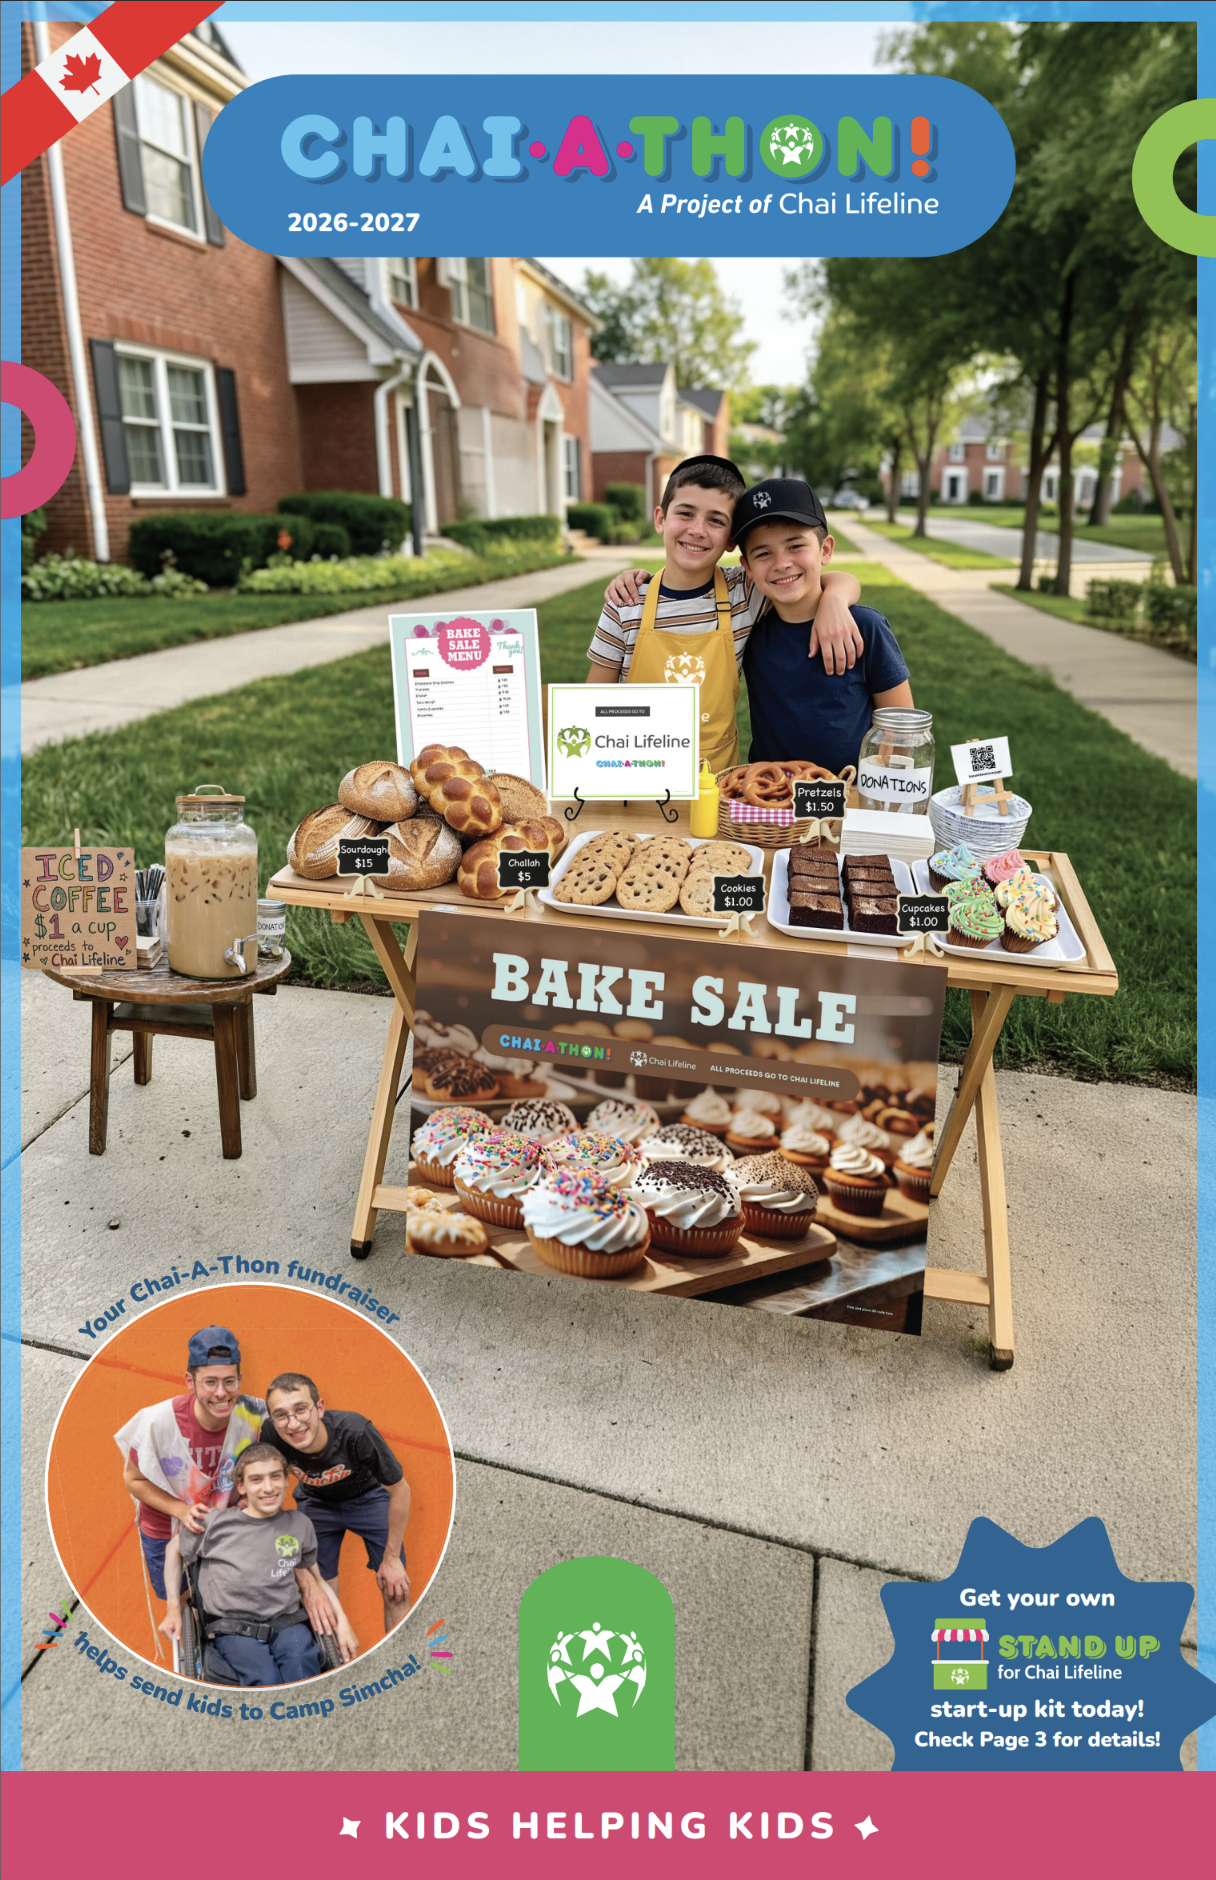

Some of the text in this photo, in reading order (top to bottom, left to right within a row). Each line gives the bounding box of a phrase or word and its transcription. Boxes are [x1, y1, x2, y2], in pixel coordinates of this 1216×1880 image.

[446, 628, 481, 639] BAKE
[449, 640, 480, 650] SALE
[496, 640, 521, 650] Thank
[447, 651, 482, 662] MENU
[595, 734, 690, 748] Chai Lifeline
[860, 774, 927, 794] DONATIONS
[798, 788, 842, 798] Pretzels
[805, 801, 834, 812] $1.50
[341, 845, 387, 857] Sourdough
[35, 854, 114, 882] ICED
[355, 858, 373, 870] $15
[508, 858, 540, 868] Challah
[517, 871, 531, 883] $5
[721, 884, 756, 893] Cookies
[32, 885, 128, 913] COFFEE
[724, 896, 752, 908] $1.00
[902, 903, 945, 915] Cupcakes
[909, 916, 938, 927] $1.00
[34, 914, 116, 942] $1 a cup
[32, 940, 94, 956] proceeds to
[51, 952, 126, 966] Chai Lifeline
[491, 953, 857, 1044] BAKE SALE
[649, 1057, 667, 1066] Chai
[668, 1060, 696, 1070] Lifeline
[710, 1065, 723, 1073] ALL
[725, 1067, 763, 1078] PROCEEDS
[790, 1076, 808, 1084] CHAI
[810, 1078, 840, 1088] LIFELINE
[278, 1558, 297, 1567] Chai
